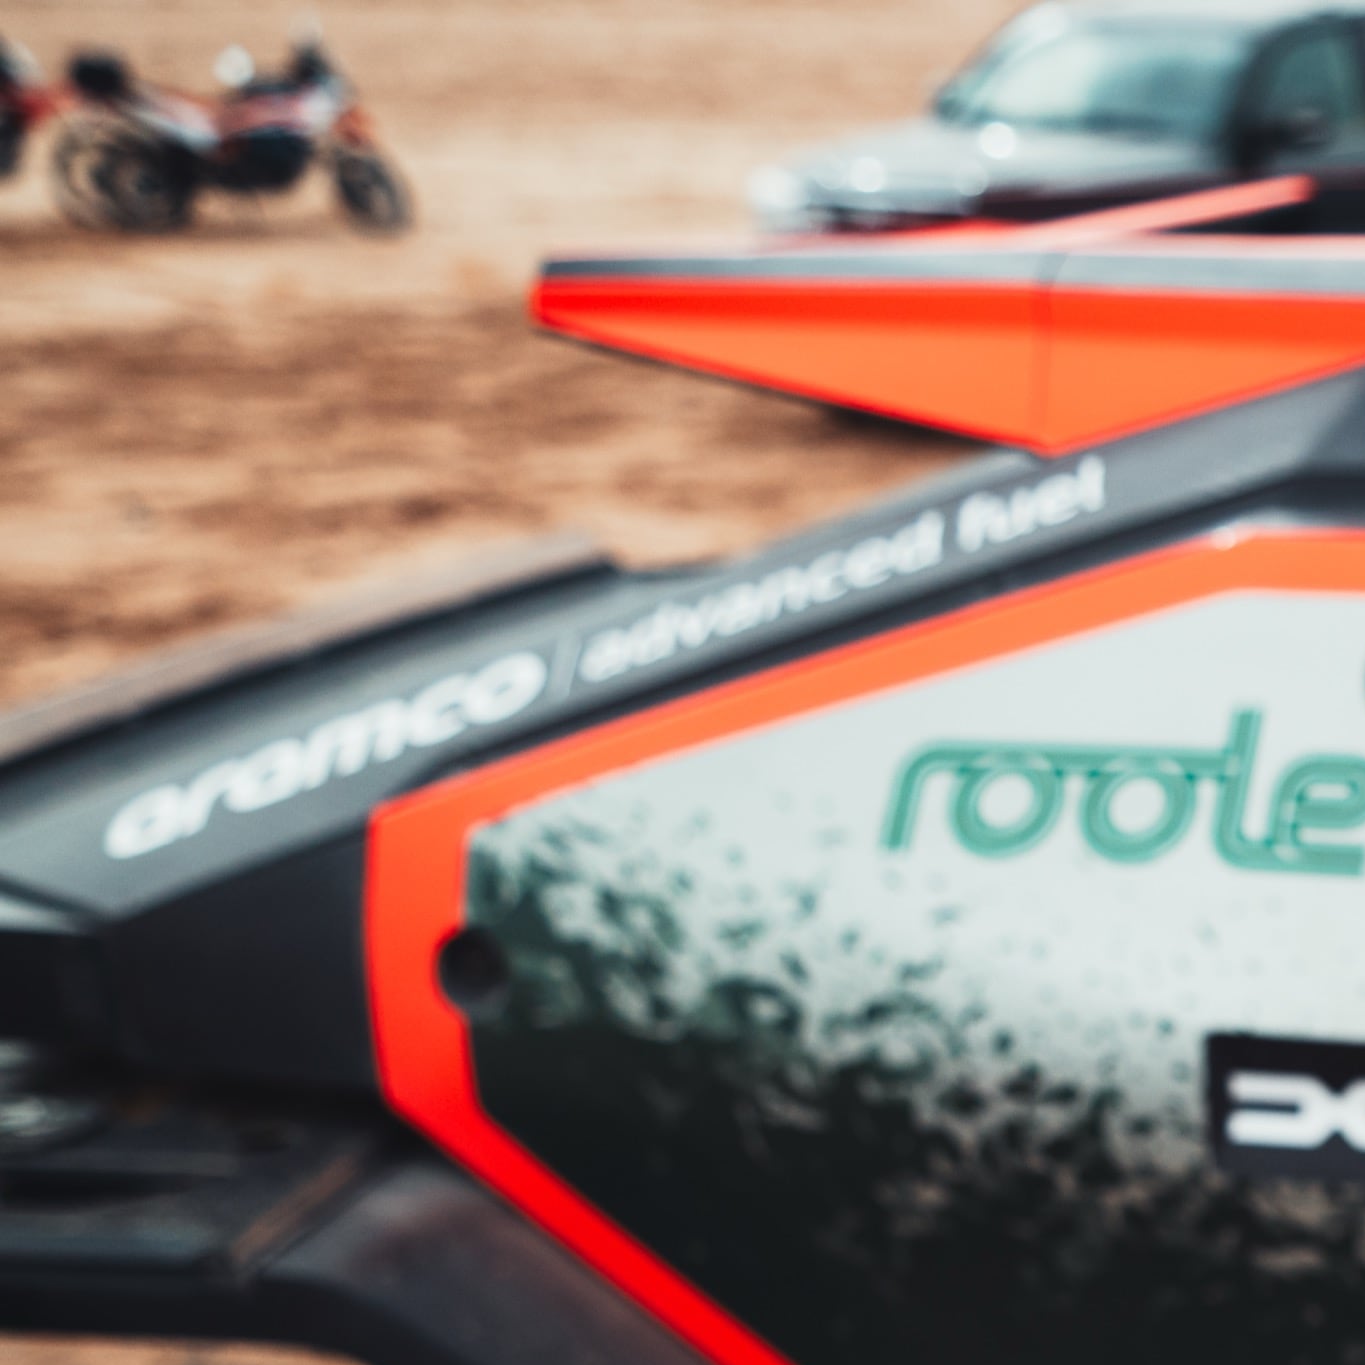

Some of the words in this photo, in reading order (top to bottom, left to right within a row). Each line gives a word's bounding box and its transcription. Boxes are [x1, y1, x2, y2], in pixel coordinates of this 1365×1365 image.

[103, 648, 547, 862] aramco
[580, 511, 945, 684] advanced
[956, 455, 1107, 554] fuel
